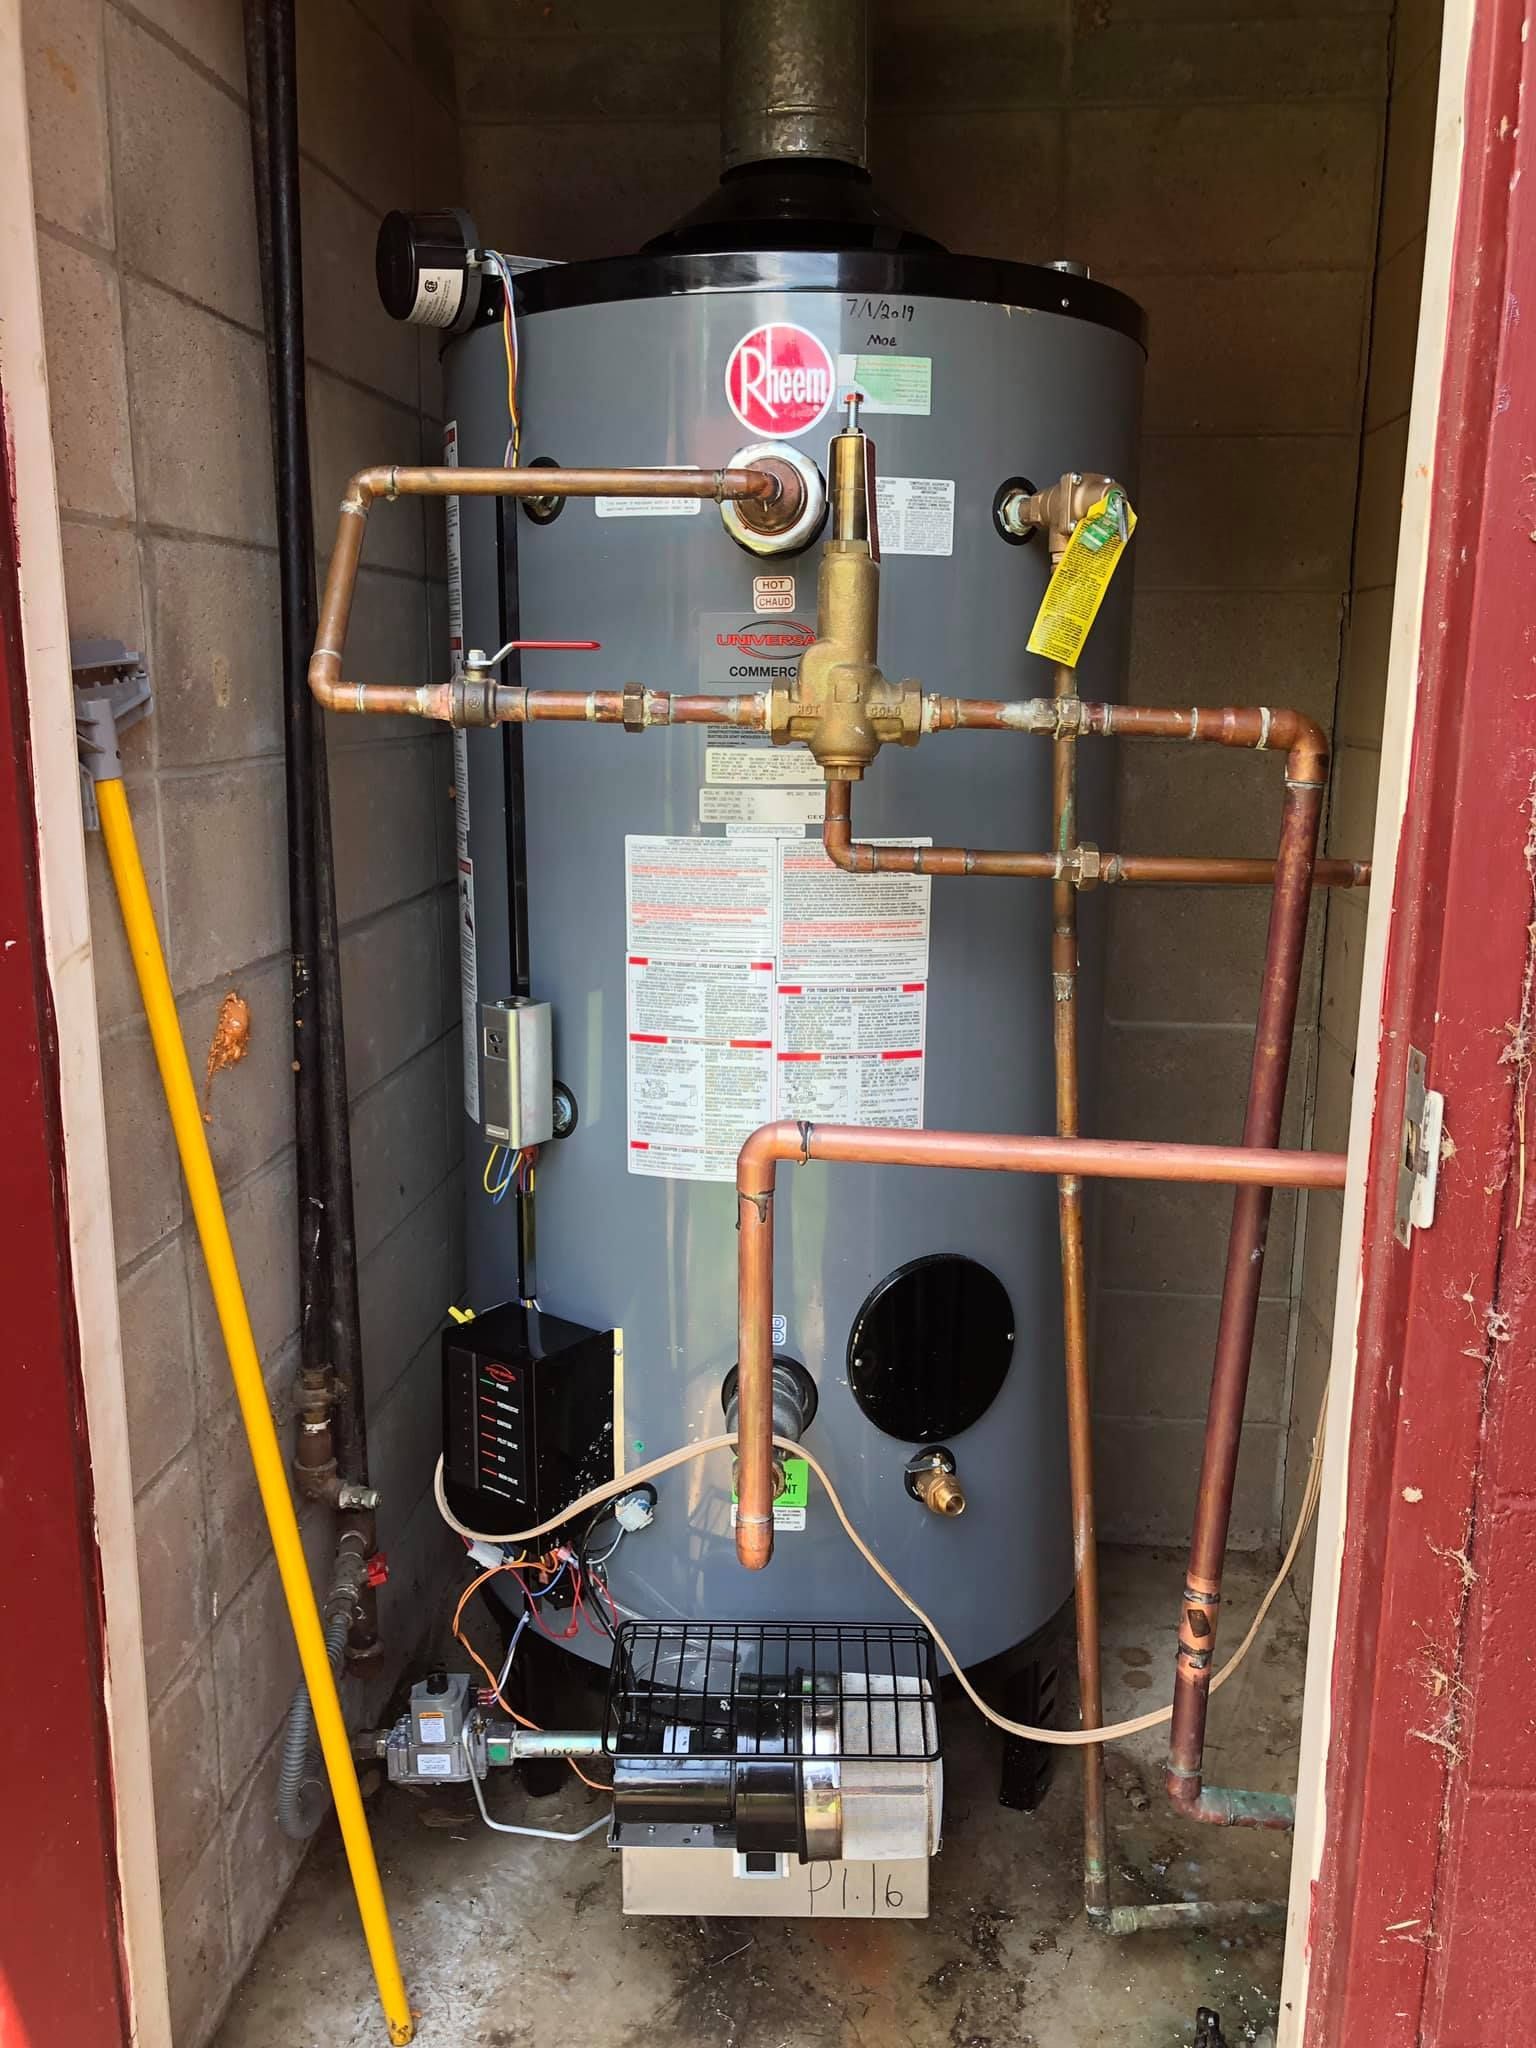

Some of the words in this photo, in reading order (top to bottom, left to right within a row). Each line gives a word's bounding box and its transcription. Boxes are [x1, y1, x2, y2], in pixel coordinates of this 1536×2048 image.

[846, 298, 915, 322] 7/1/2019
[740, 327, 827, 418] Rheem
[762, 580, 785, 590] HOT
[758, 597, 791, 607] CHAUD
[798, 703, 821, 715] HOT
[870, 706, 902, 717] COLD
